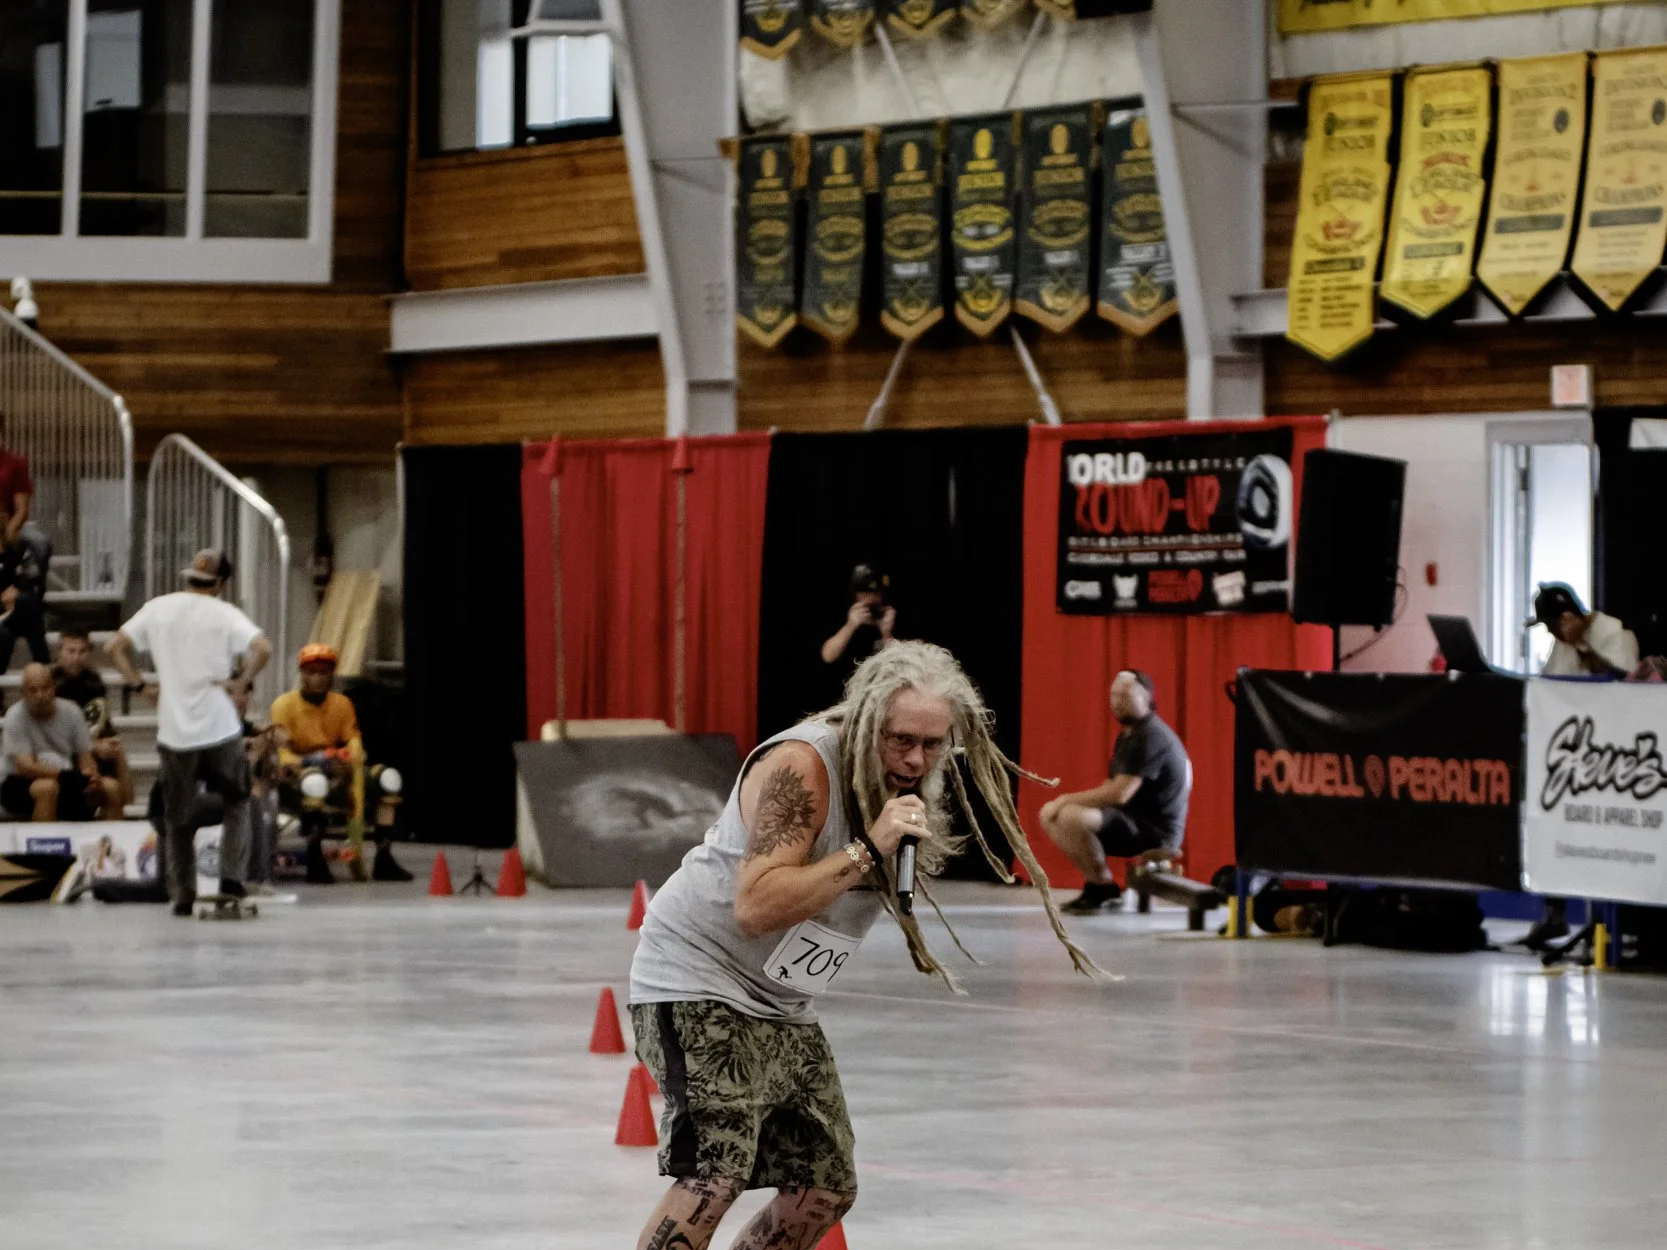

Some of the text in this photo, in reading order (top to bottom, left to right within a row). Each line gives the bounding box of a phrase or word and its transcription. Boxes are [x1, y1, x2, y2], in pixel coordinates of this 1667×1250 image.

[1068, 451, 1146, 485] ORLD
[1254, 749, 1511, 806] POWELL PERALTA
[1541, 715, 1667, 811] Steve's
[791, 936, 849, 984] 709
